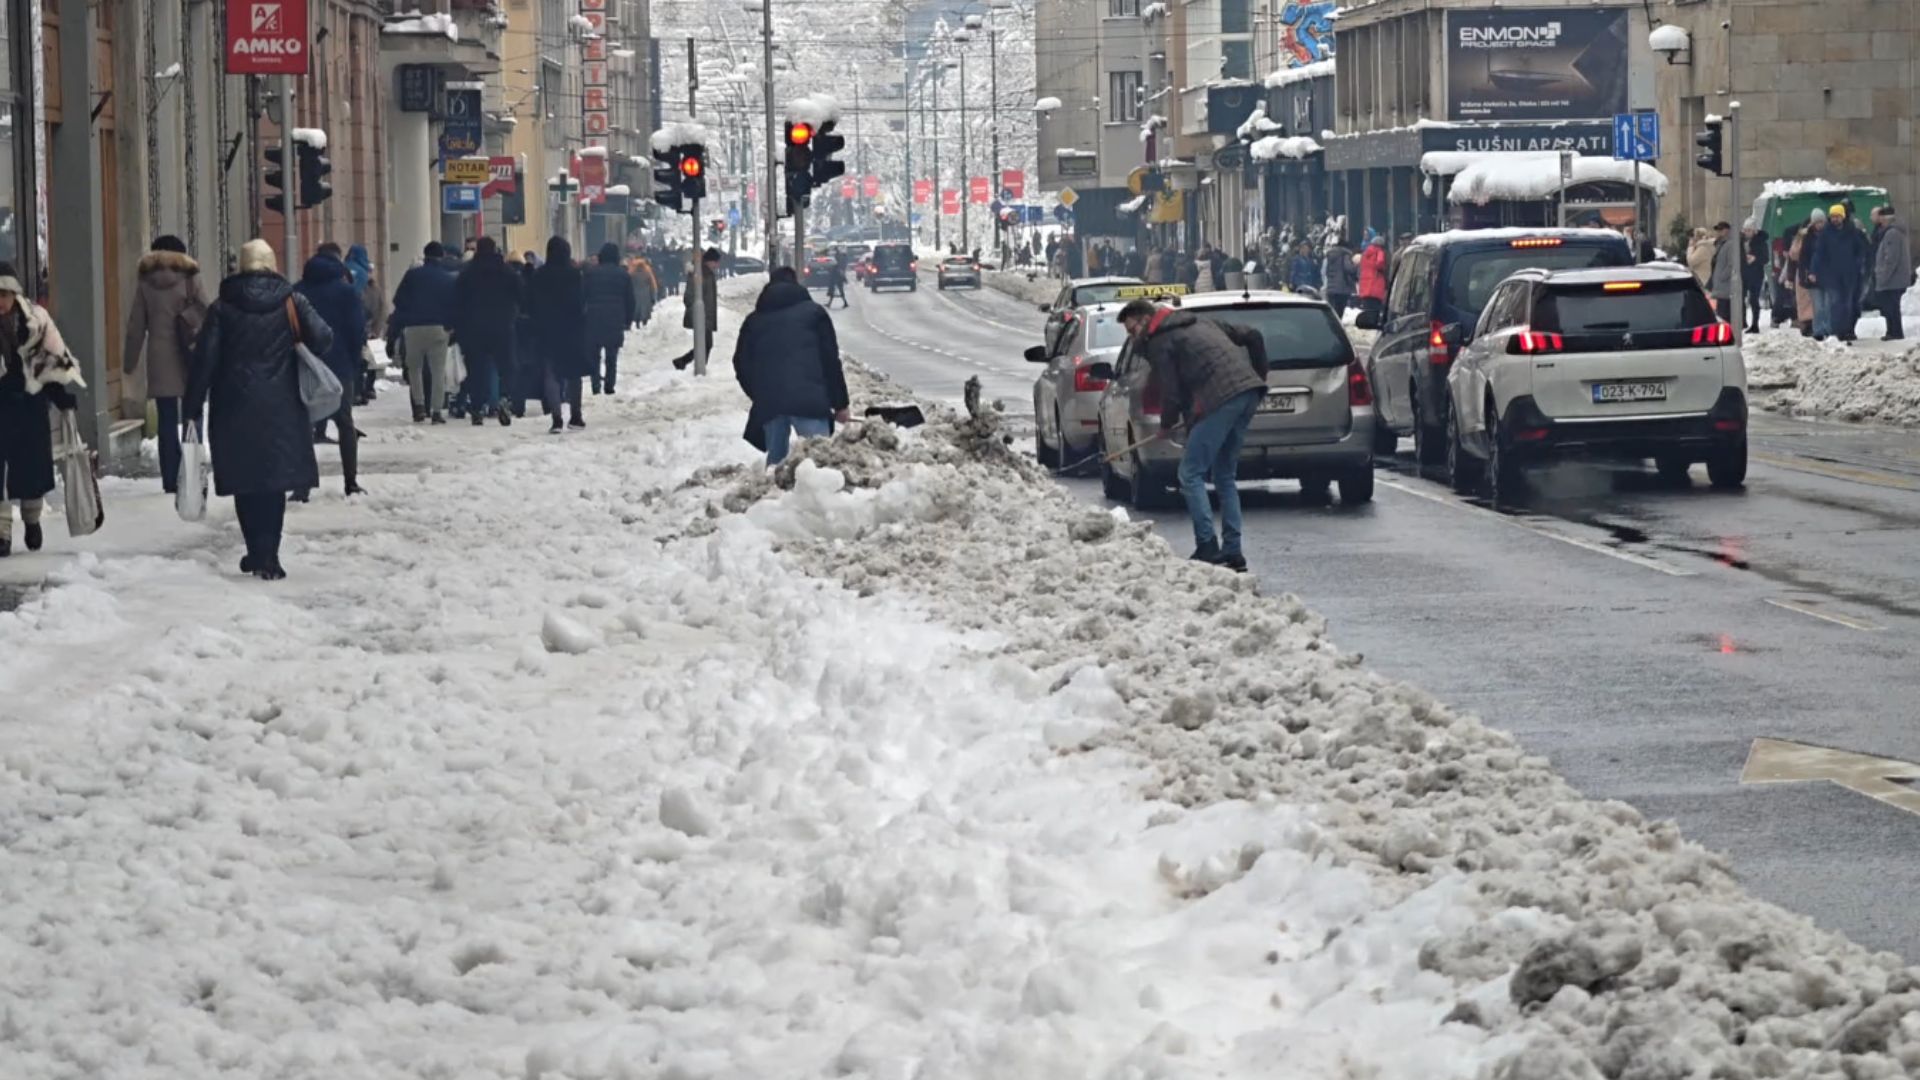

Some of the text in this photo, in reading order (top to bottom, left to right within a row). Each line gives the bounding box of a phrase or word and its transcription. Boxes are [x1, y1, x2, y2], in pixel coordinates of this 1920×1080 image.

[1460, 26, 1539, 40] ENMON
[233, 37, 301, 54] AMKO
[1460, 40, 1514, 48] PROJECT
[1456, 135, 1606, 151] SLUŠNI APARATI
[449, 163, 485, 172] NOTAR
[1148, 286, 1178, 295] TAXI
[1602, 383, 1663, 398] 023-K-794
